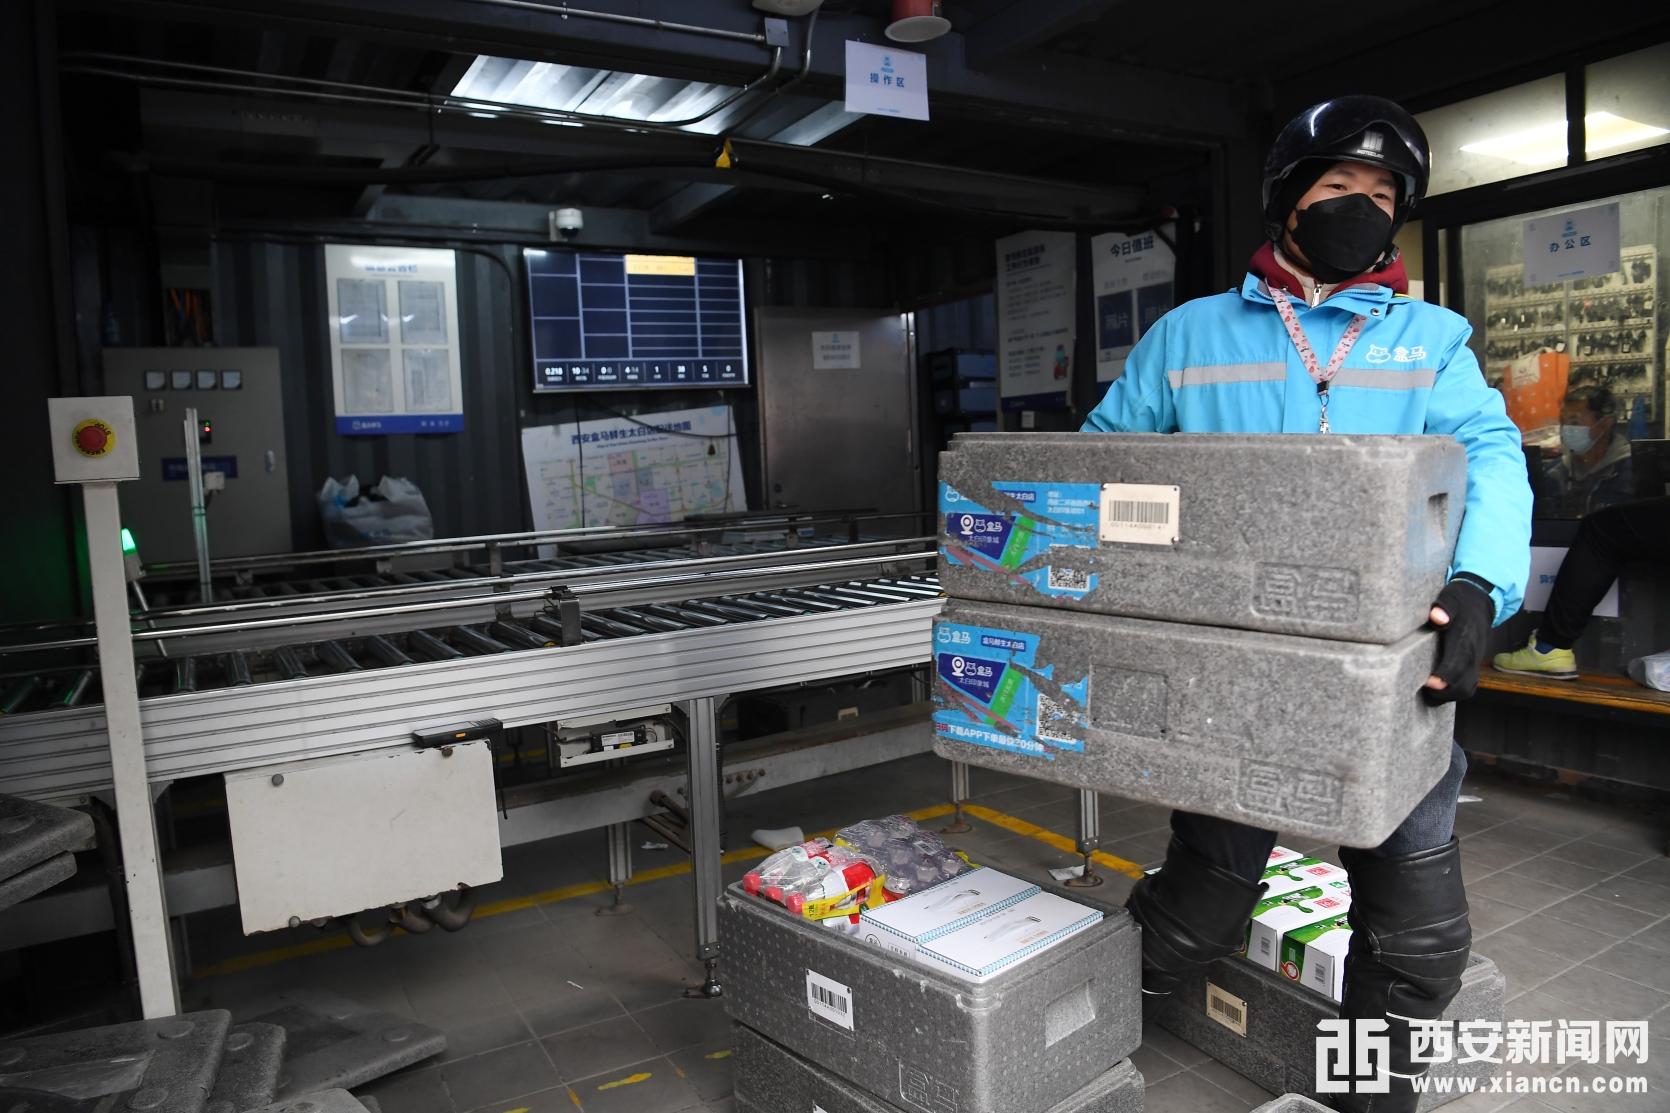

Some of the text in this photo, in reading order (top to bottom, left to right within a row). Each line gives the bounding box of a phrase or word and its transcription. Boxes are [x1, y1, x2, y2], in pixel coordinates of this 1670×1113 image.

[869, 72, 905, 88] 操作区
[1110, 235, 1154, 257] 今日值班
[1549, 235, 1591, 253] 办公区
[1392, 345, 1427, 363] 盒马
[986, 521, 1003, 533] 盒马
[951, 630, 971, 645] 盒马
[977, 665, 993, 677] 盒马
